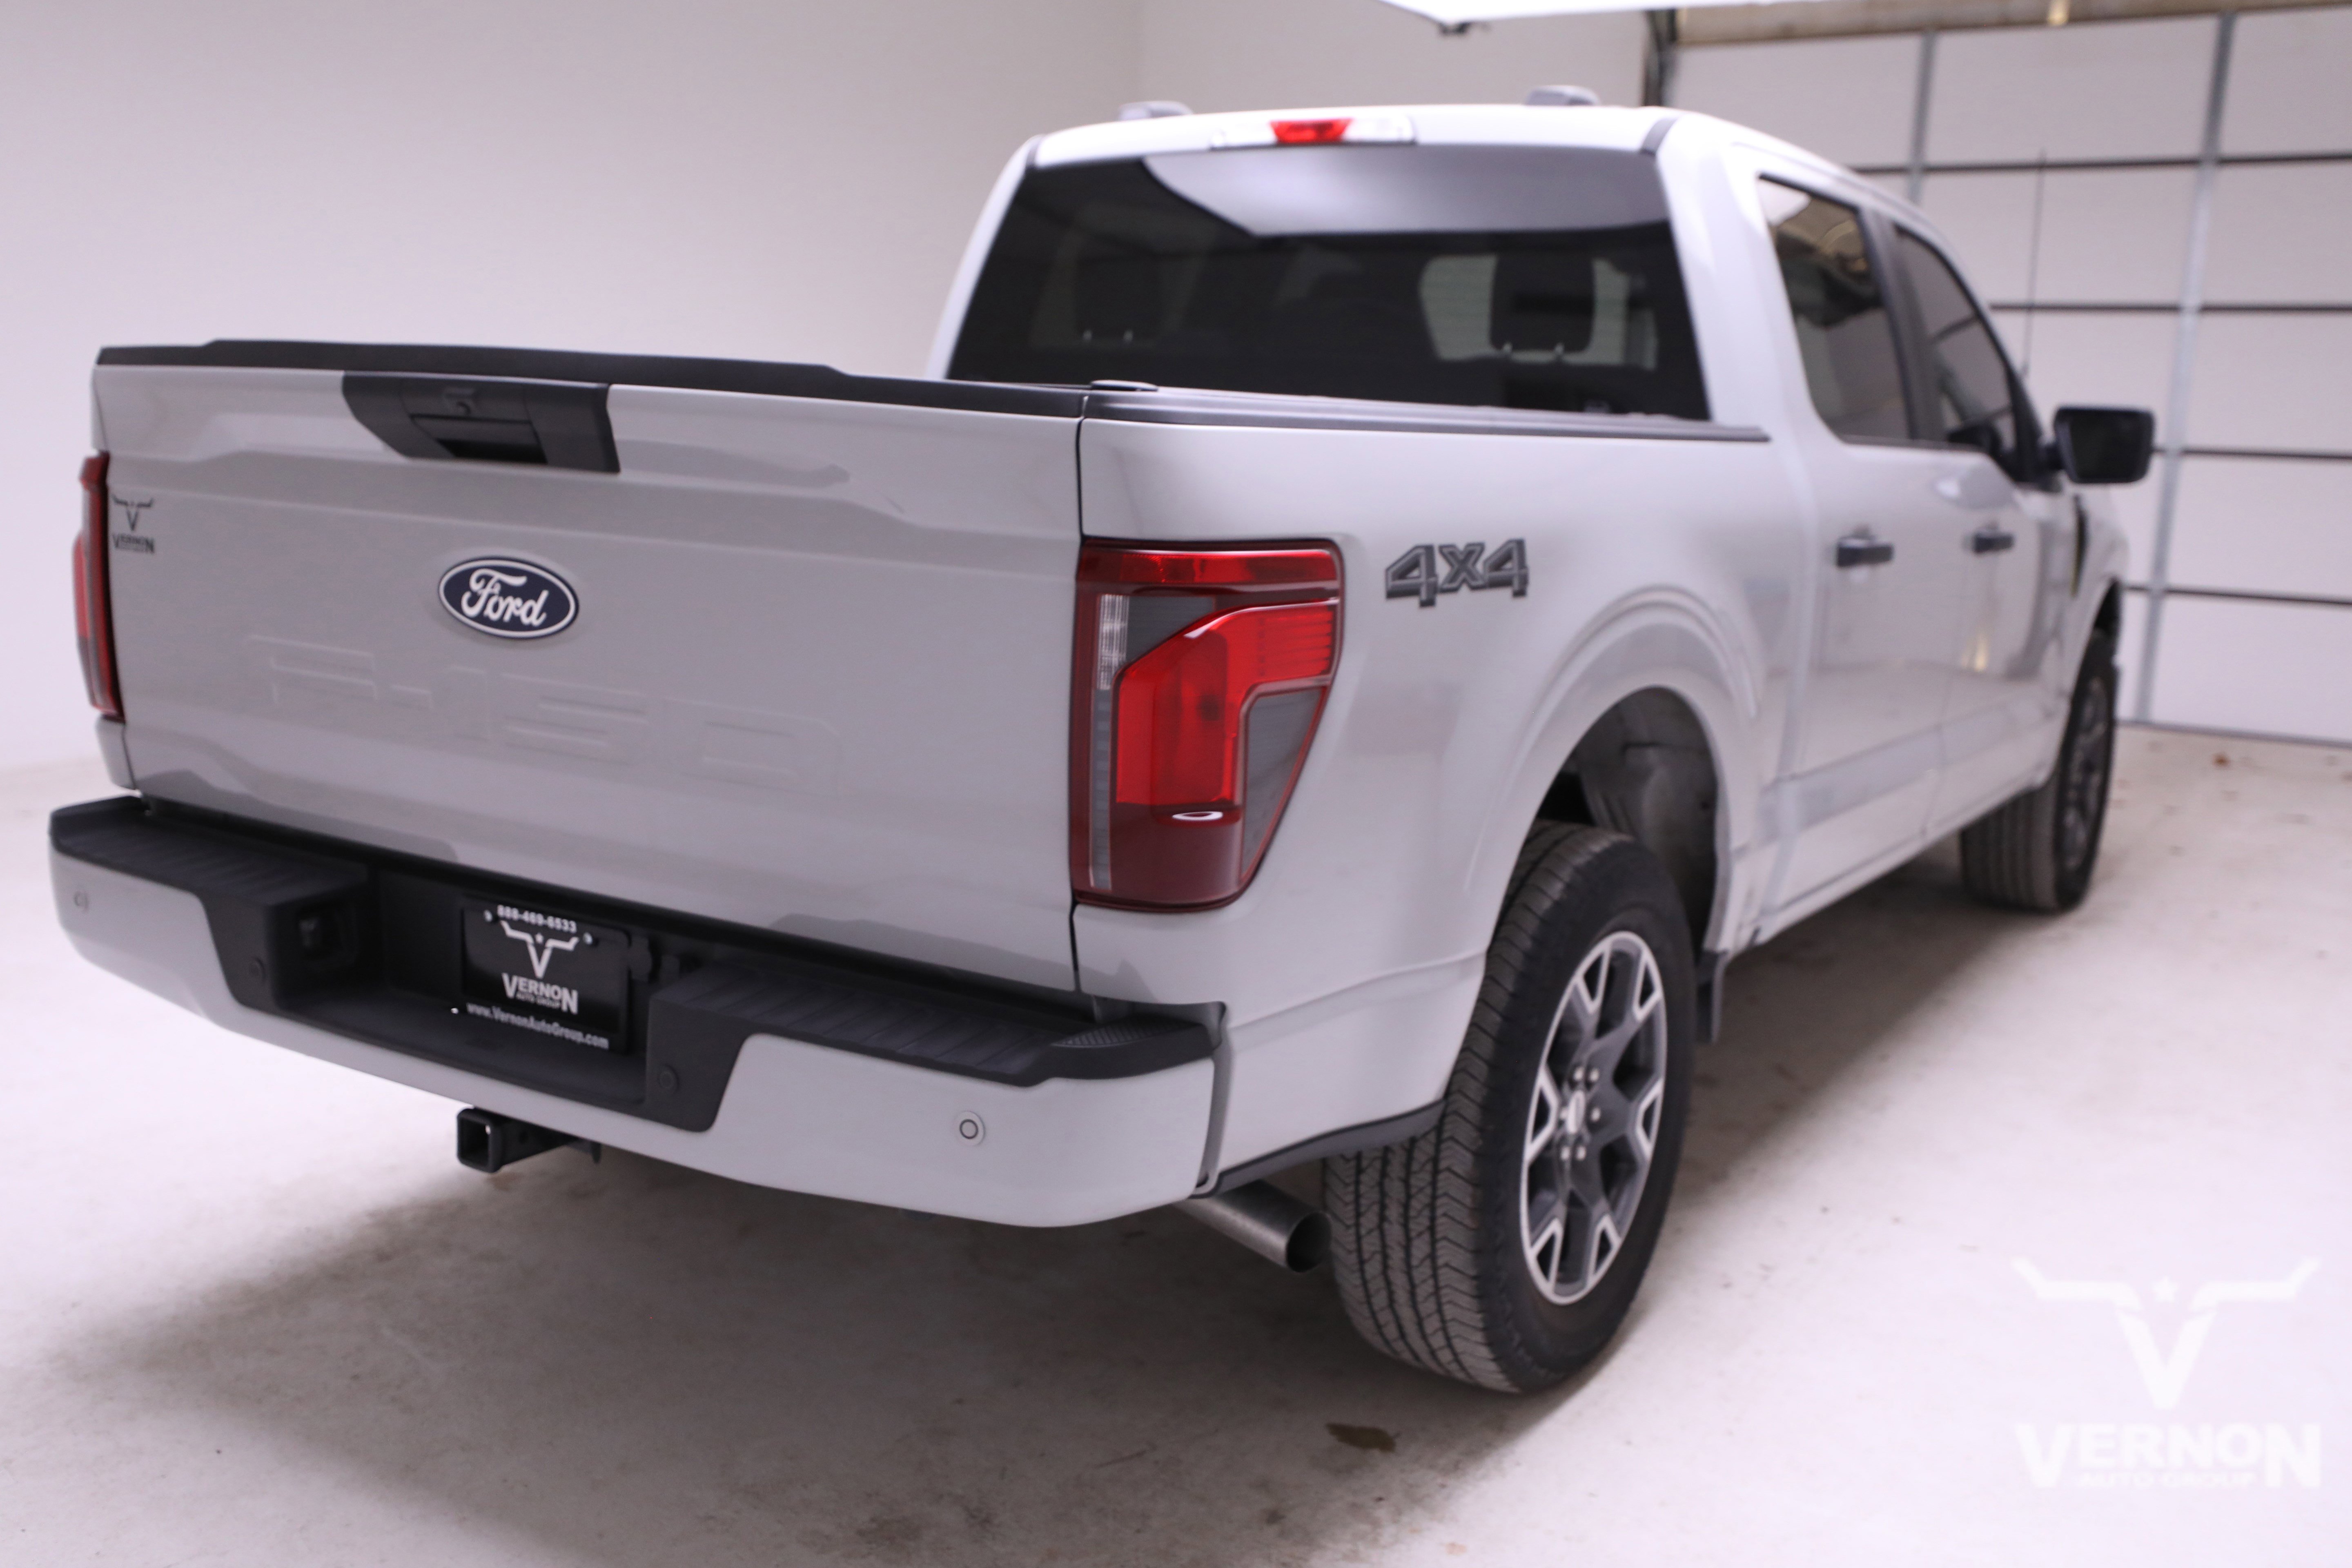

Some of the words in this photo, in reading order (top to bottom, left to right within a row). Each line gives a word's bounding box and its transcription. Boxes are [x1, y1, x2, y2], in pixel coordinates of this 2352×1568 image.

[461, 568, 549, 626] Ford
[502, 972, 578, 1015] VERNON
[466, 1002, 609, 1050] www.VernonAutoGroup.com
